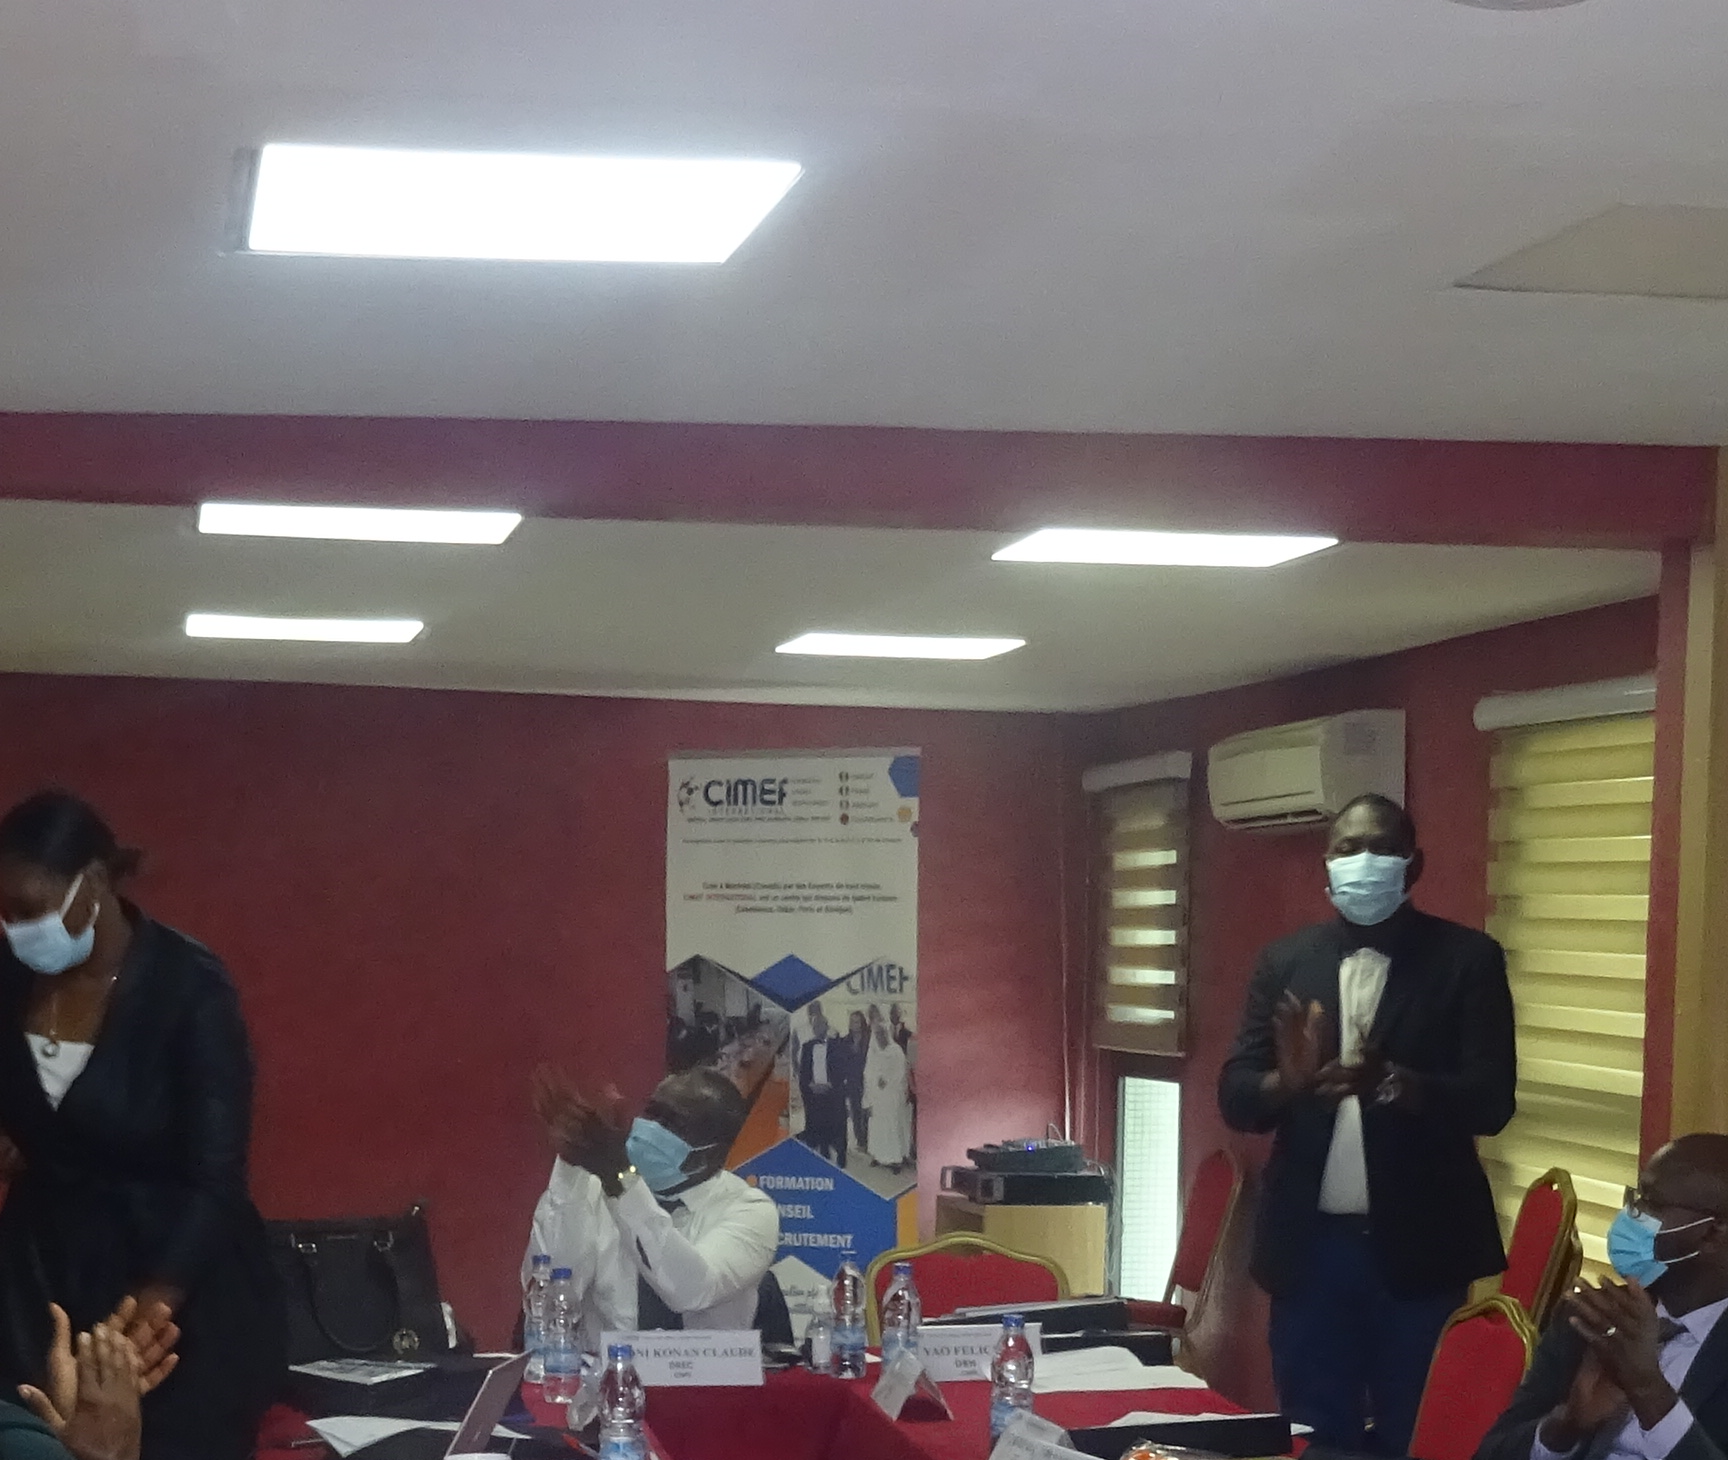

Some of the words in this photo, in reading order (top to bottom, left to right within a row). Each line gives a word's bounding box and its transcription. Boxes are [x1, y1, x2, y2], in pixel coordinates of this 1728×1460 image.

[758, 1175, 834, 1191] FORMATION
[777, 1204, 814, 1219] NSEIL
[778, 1232, 854, 1249] CRUTEMENT
